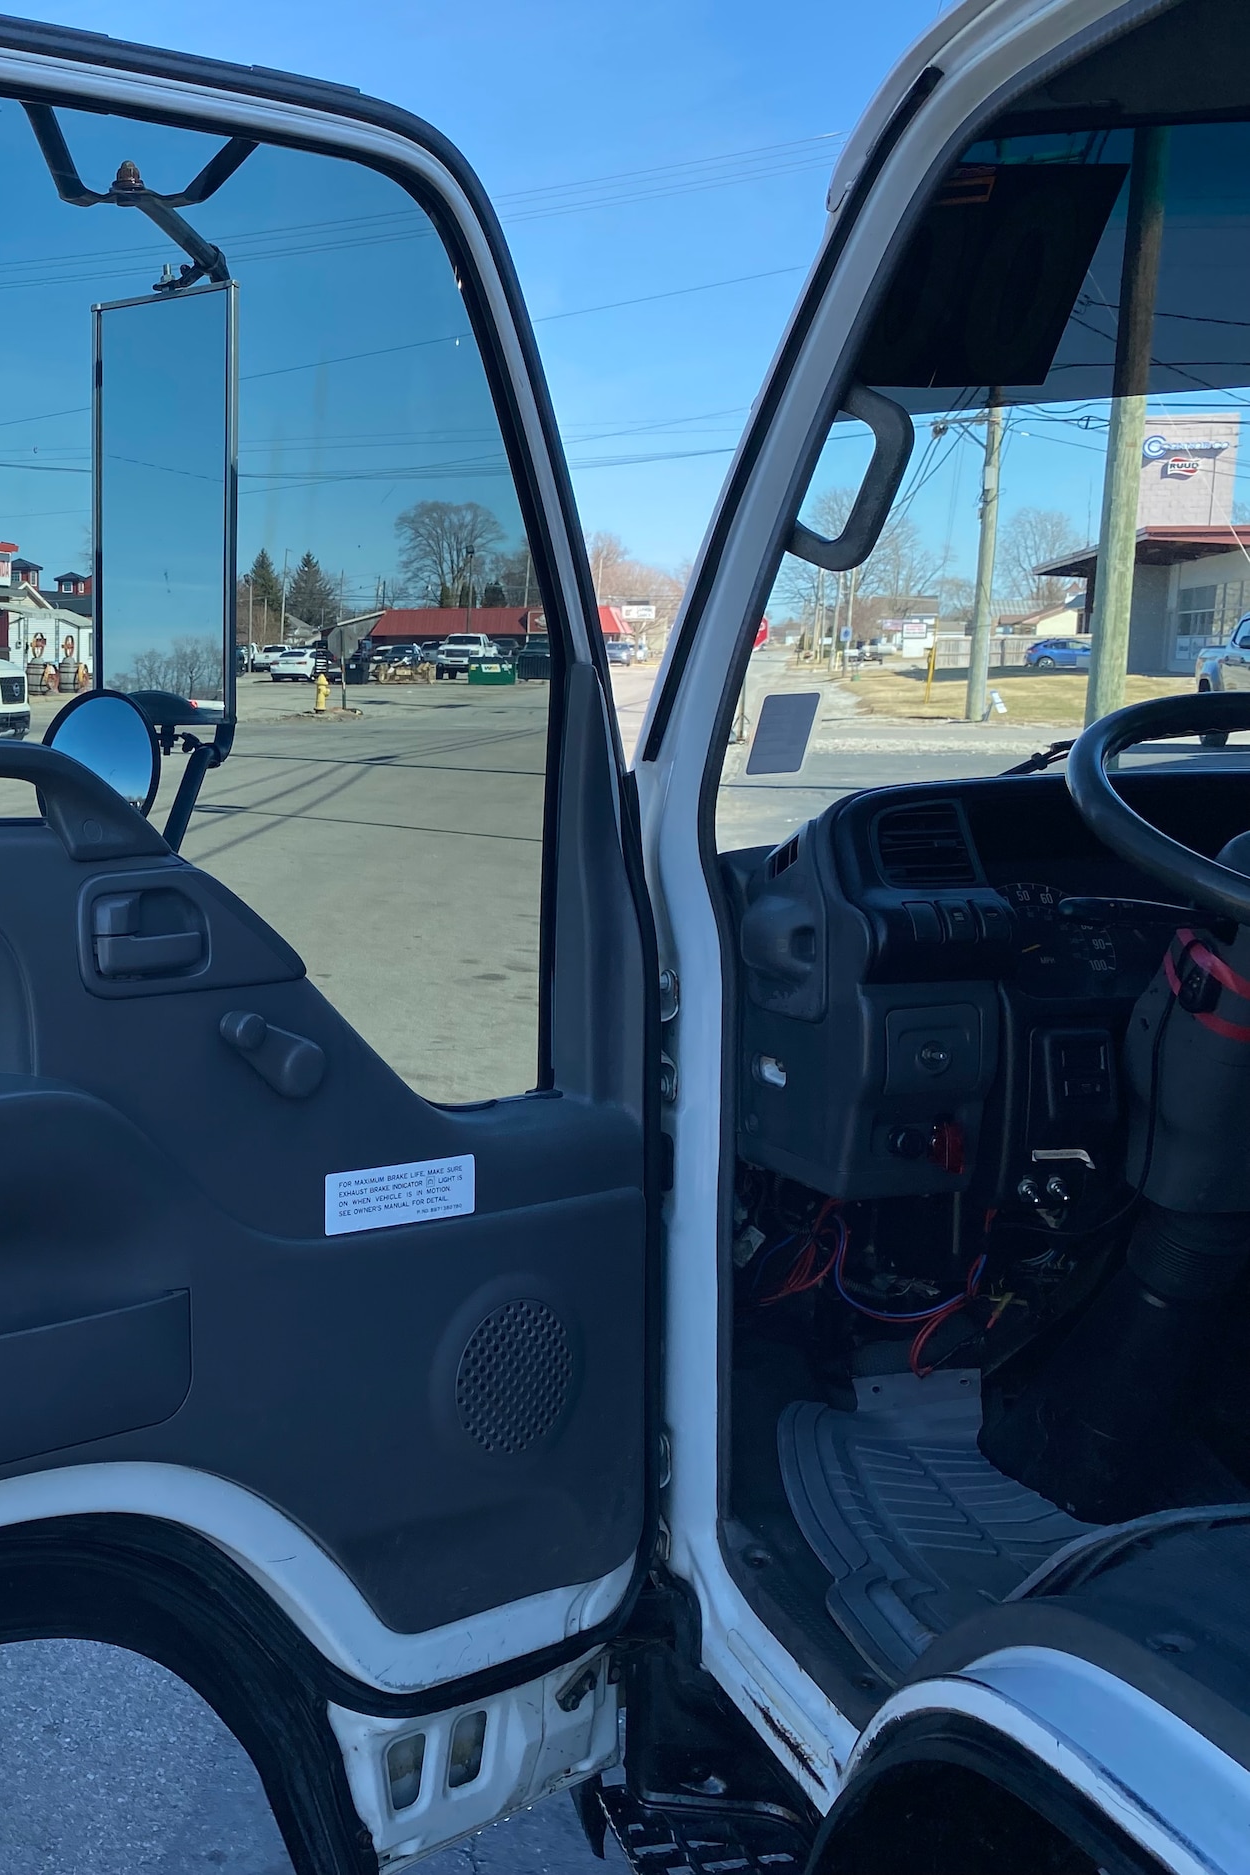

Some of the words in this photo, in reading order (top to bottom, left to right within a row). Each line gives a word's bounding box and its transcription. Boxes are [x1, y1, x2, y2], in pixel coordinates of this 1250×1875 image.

[1169, 462, 1199, 470] RUUD
[1016, 890, 1031, 902] 50
[1040, 893, 1054, 905] 60
[1092, 938, 1106, 950] 90
[1089, 959, 1108, 971] 100
[338, 1180, 352, 1189] FOR
[354, 1176, 385, 1186] MAXIMUM
[387, 1172, 409, 1182] BRAKE
[427, 1167, 445, 1175] MAKE
[446, 1165, 463, 1173] SURE
[338, 1188, 368, 1198] EXHAUST
[369, 1184, 391, 1194] BRAKE
[392, 1180, 423, 1190] INDICATOR
[437, 1175, 456, 1184] LIGHT
[338, 1200, 349, 1208] ON
[352, 1197, 371, 1205] WHEN
[375, 1192, 402, 1202] VEHICLE
[406, 1190, 413, 1198] IS
[338, 1209, 352, 1217] SEE
[353, 1204, 383, 1215] OWNER'S
[384, 1201, 410, 1210] MANUAL
[411, 1198, 425, 1206] FOR
